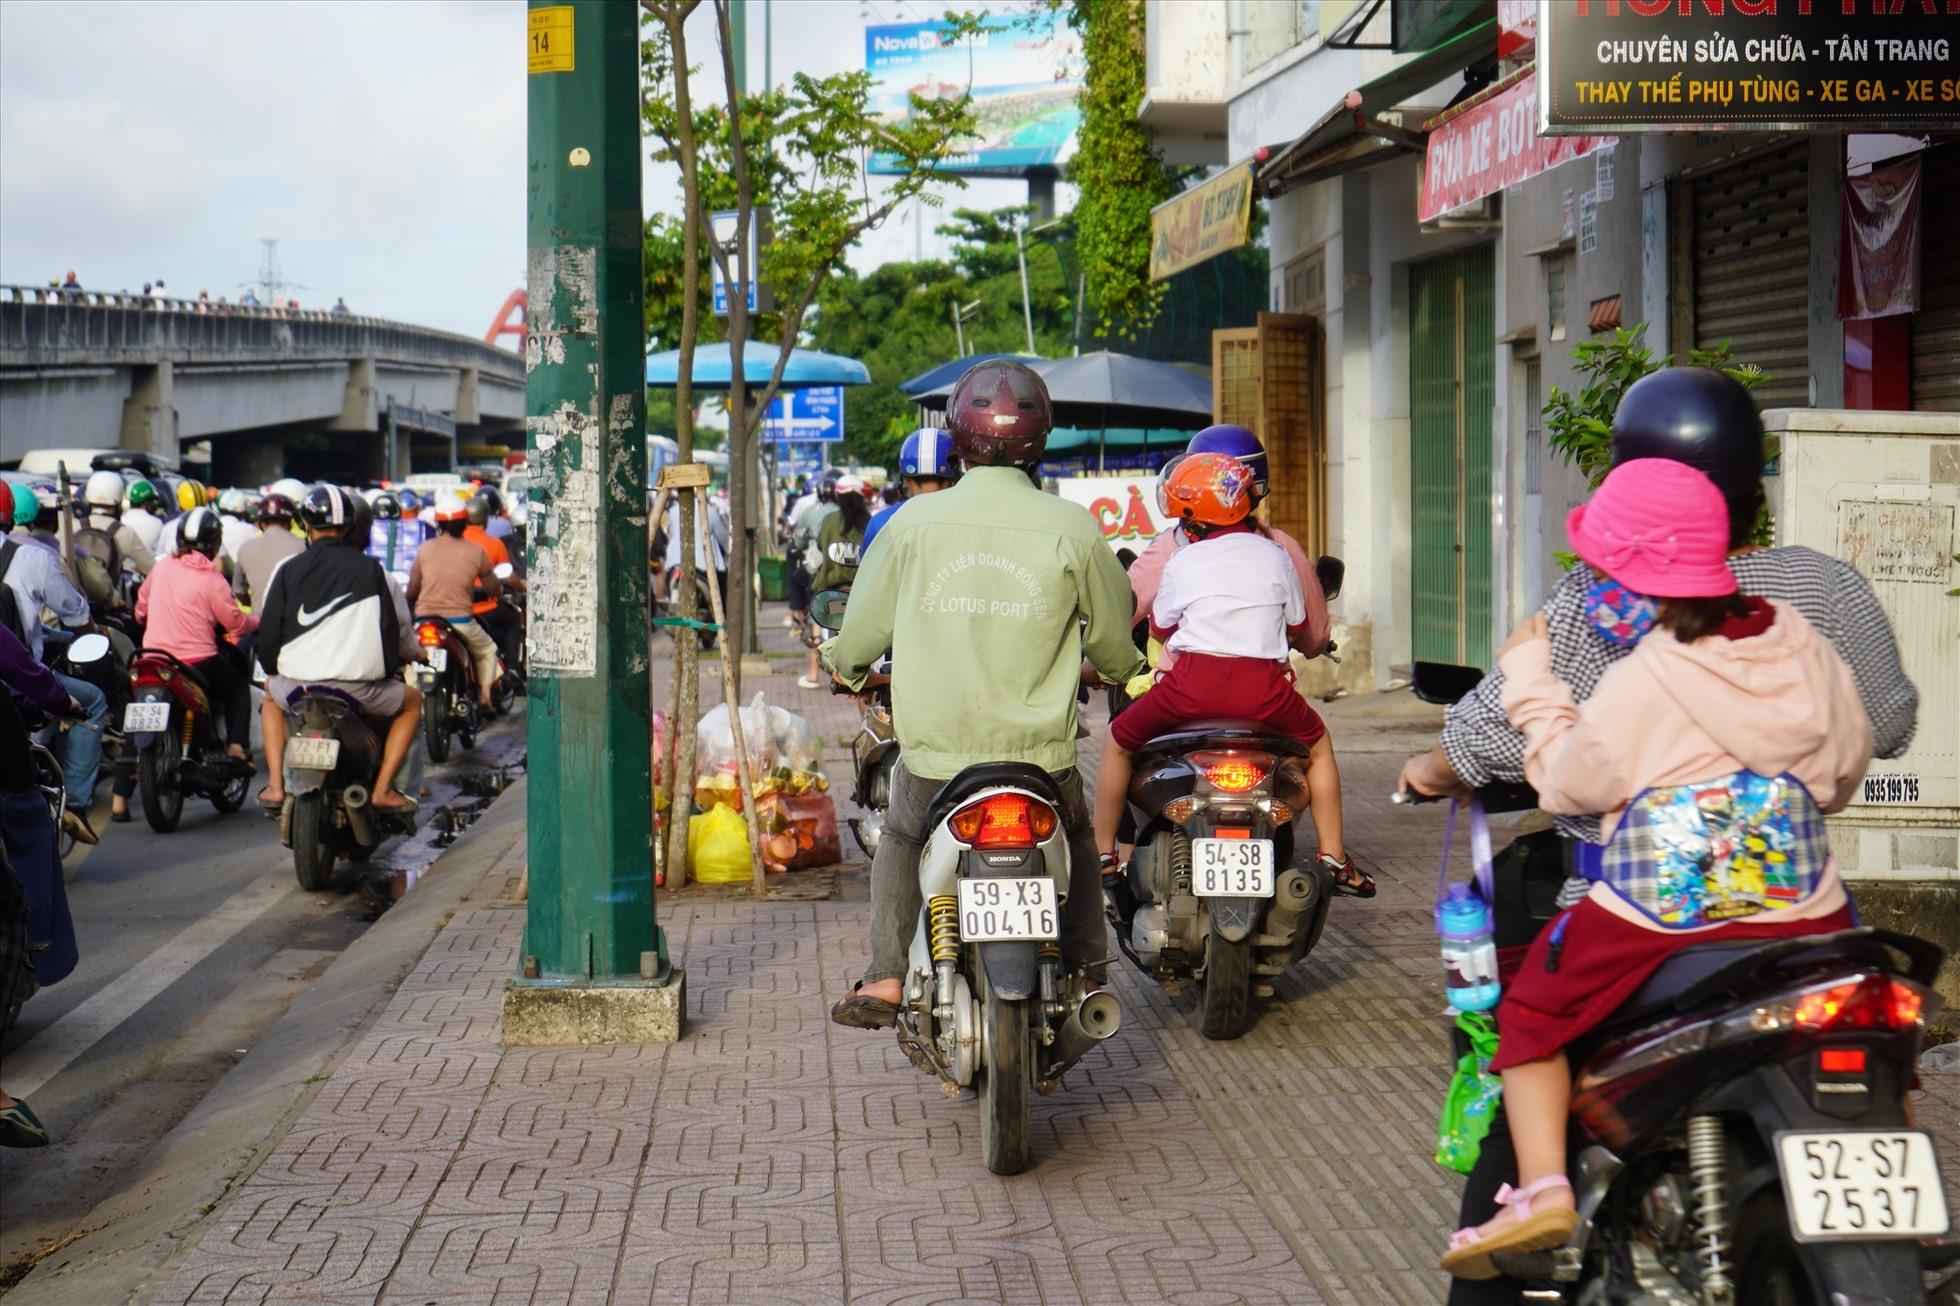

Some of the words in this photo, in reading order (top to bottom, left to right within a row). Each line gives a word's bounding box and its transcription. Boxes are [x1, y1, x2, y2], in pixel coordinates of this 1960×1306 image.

[532, 31, 549, 54] 14
[1597, 34, 1688, 63] CHUYÊN
[1694, 31, 1739, 63] SỬA
[1745, 34, 1806, 62] CHỮA
[1825, 34, 1868, 62] TÂN
[1875, 39, 1950, 62] TRANG
[1575, 80, 1632, 104] THAY
[1638, 71, 1683, 104] THẾ
[1689, 79, 1733, 108] PHỤ
[1740, 74, 1800, 103] TÙNG
[1820, 80, 1849, 102] XE
[1855, 79, 1886, 102] GA
[1905, 80, 1934, 102] XE
[1467, 113, 1494, 177] XE
[1088, 484, 1159, 541] CÀ
[920, 581, 942, 614] CÔNG
[935, 565, 952, 582] TY
[950, 552, 976, 574] LIÊN
[978, 552, 1018, 575] DOANH
[1033, 597, 1048, 620] SEN
[940, 597, 986, 614] LOTUS
[990, 600, 1031, 618] PORT
[1205, 843, 1261, 866] 54-S8
[973, 881, 1042, 906] 59-X3
[1205, 868, 1261, 892] 8135
[966, 909, 1053, 936] 004.16
[1804, 1138, 1908, 1179] 52-S7
[1814, 1186, 1919, 1230] 2537
